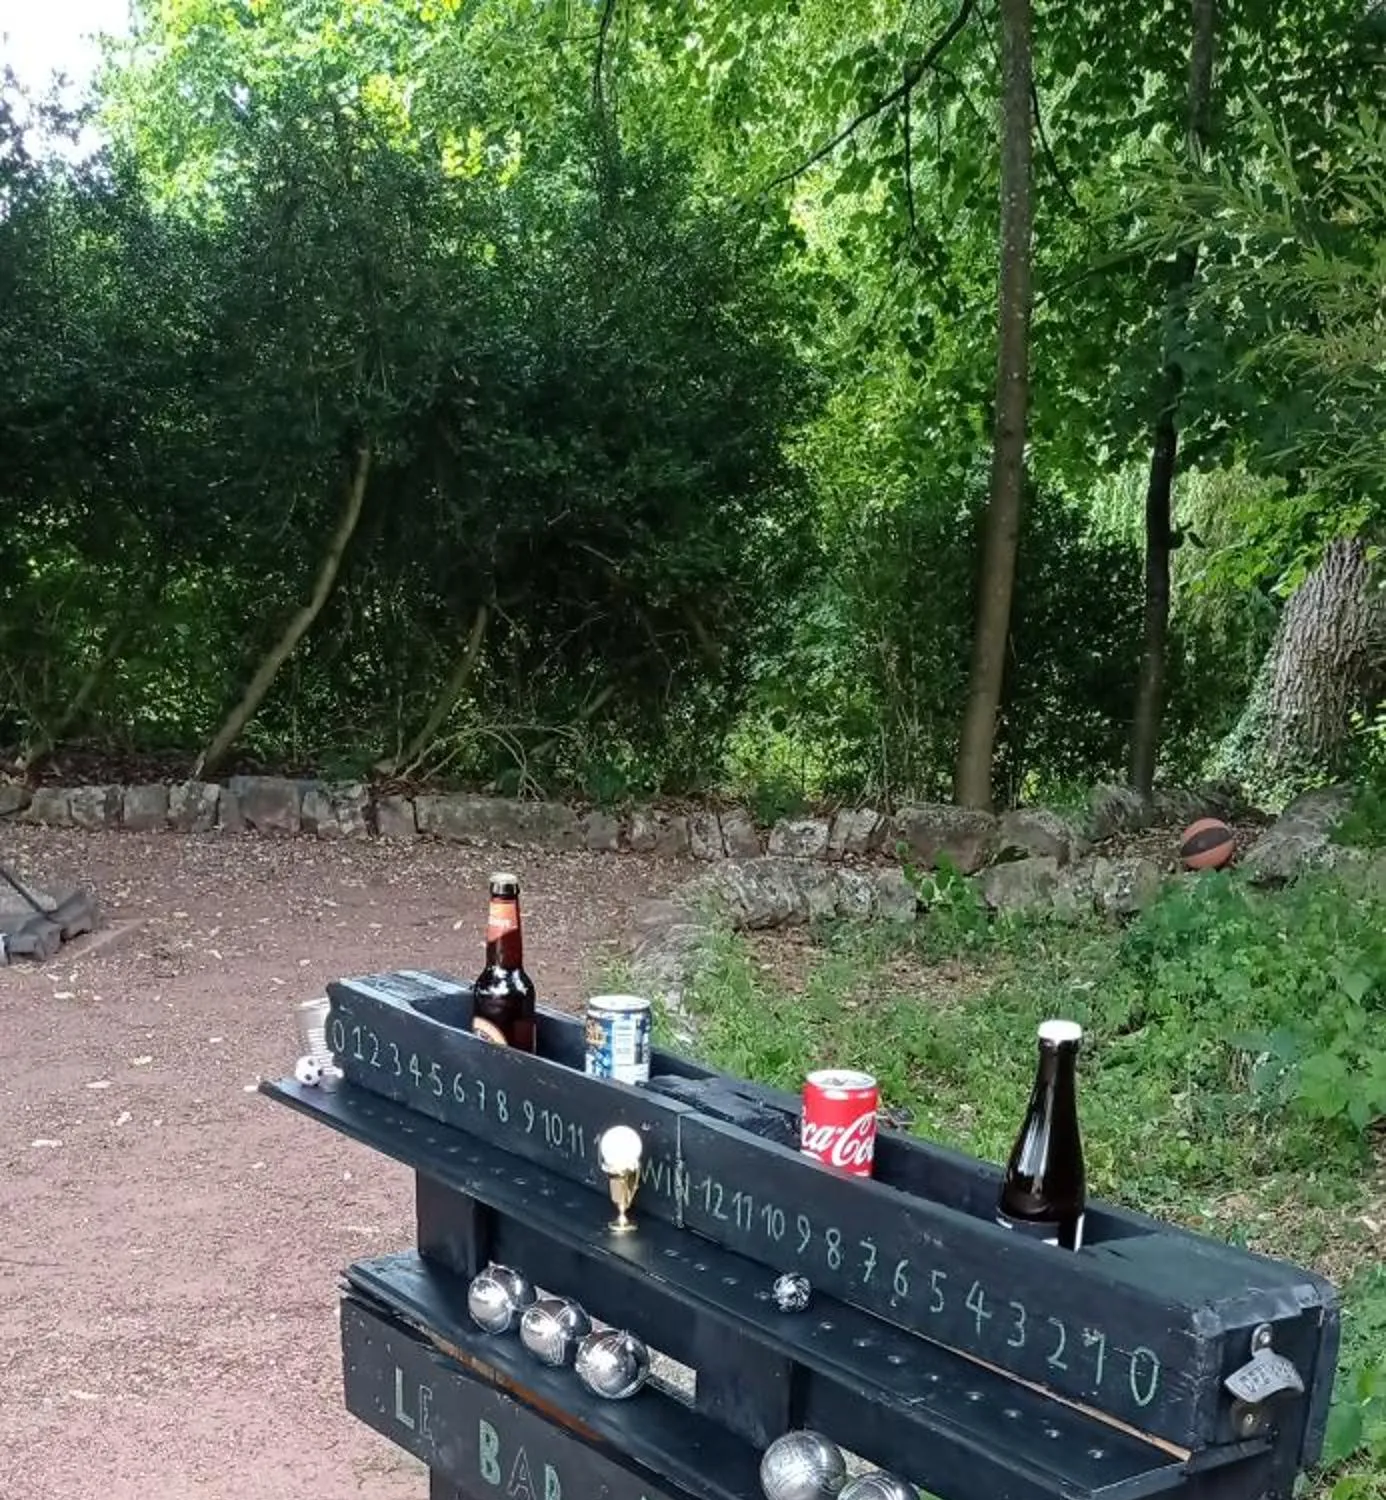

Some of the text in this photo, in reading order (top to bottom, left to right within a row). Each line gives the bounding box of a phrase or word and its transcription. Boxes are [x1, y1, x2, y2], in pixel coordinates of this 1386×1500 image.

[333, 1019, 345, 1053] 0
[352, 1025, 364, 1060] 1
[368, 1032, 381, 1068] 2
[389, 1042, 401, 1076] 3
[409, 1053, 422, 1087] 4
[427, 1062, 443, 1097] 5
[453, 1072, 465, 1103] 6
[475, 1080, 486, 1111] 7
[496, 1089, 509, 1123] 8
[523, 1099, 535, 1134] 9
[541, 1109, 564, 1146] 10
[567, 1122, 586, 1159] 11
[699, 1175, 729, 1221] 12
[761, 1203, 786, 1242] 10
[797, 1214, 812, 1254] 9
[825, 1227, 842, 1271] 8
[859, 1239, 878, 1284] 7
[893, 1259, 910, 1298] 6
[929, 1269, 948, 1313] 5
[965, 1280, 993, 1340] 4
[1007, 1301, 1027, 1347] 3
[1048, 1317, 1068, 1371] 2
[1081, 1327, 1106, 1386] 1
[1130, 1346, 1161, 1407] 0
[395, 1366, 434, 1444] LE
